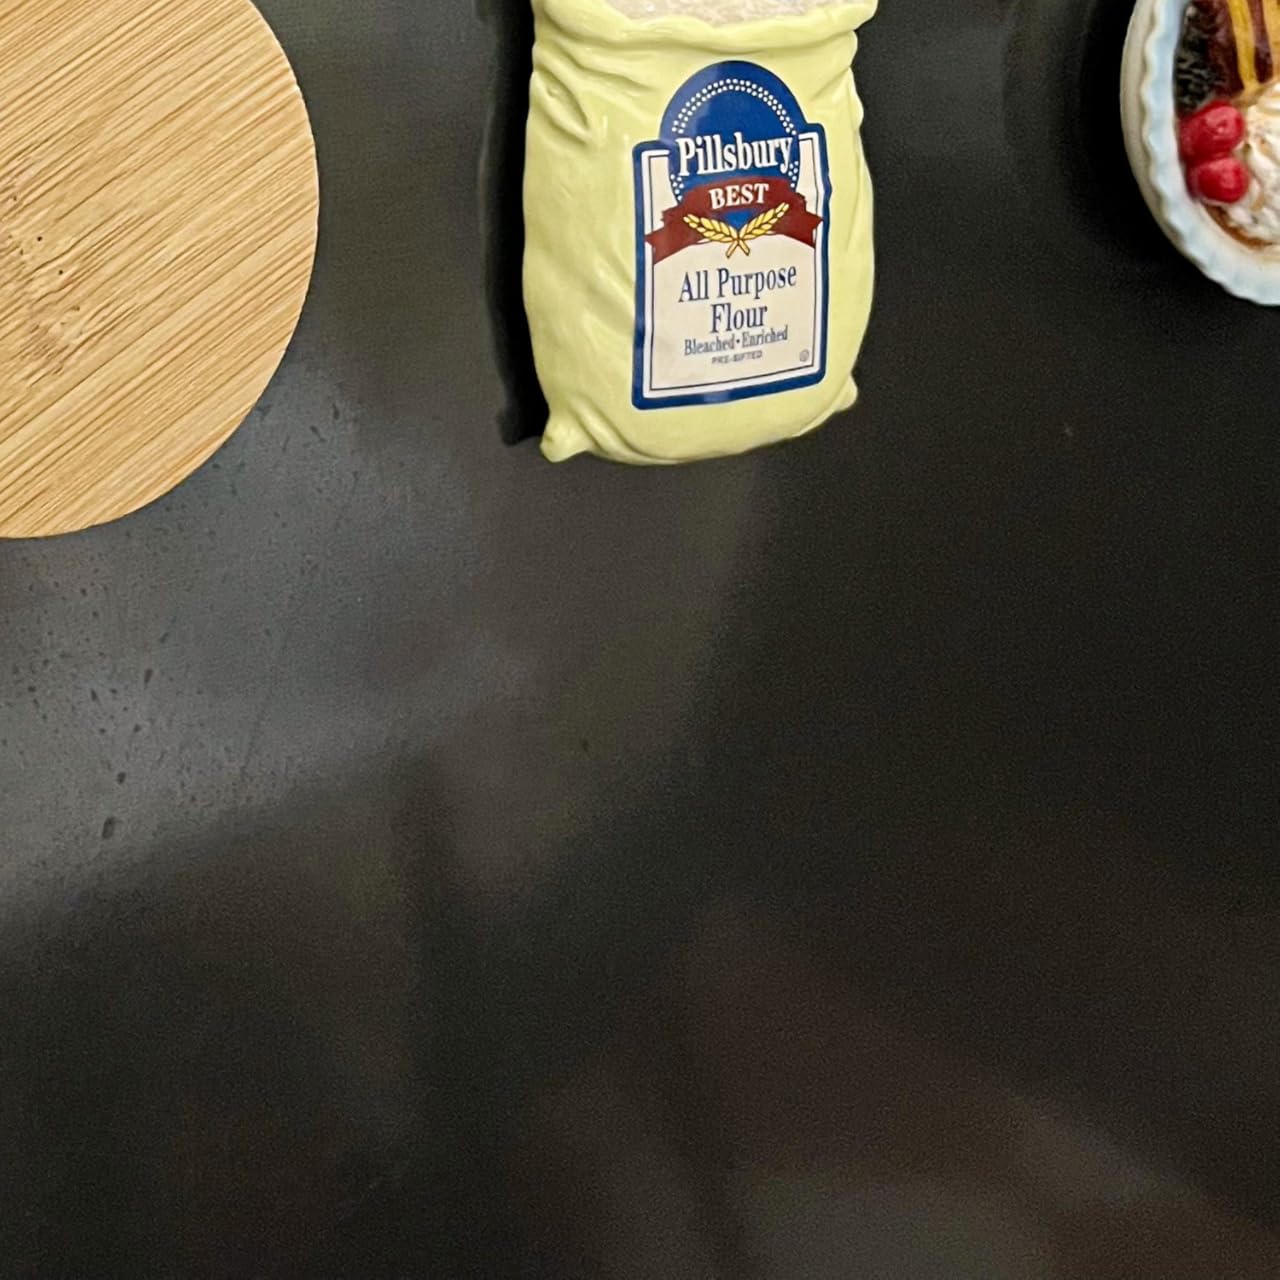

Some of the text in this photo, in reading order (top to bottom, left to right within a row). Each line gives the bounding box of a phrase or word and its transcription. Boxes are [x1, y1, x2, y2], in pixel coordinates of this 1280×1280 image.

[676, 132, 793, 177] Pillsbury
[709, 183, 769, 210] BEST
[678, 265, 797, 303] All Purpose
[710, 303, 768, 333] Flour
